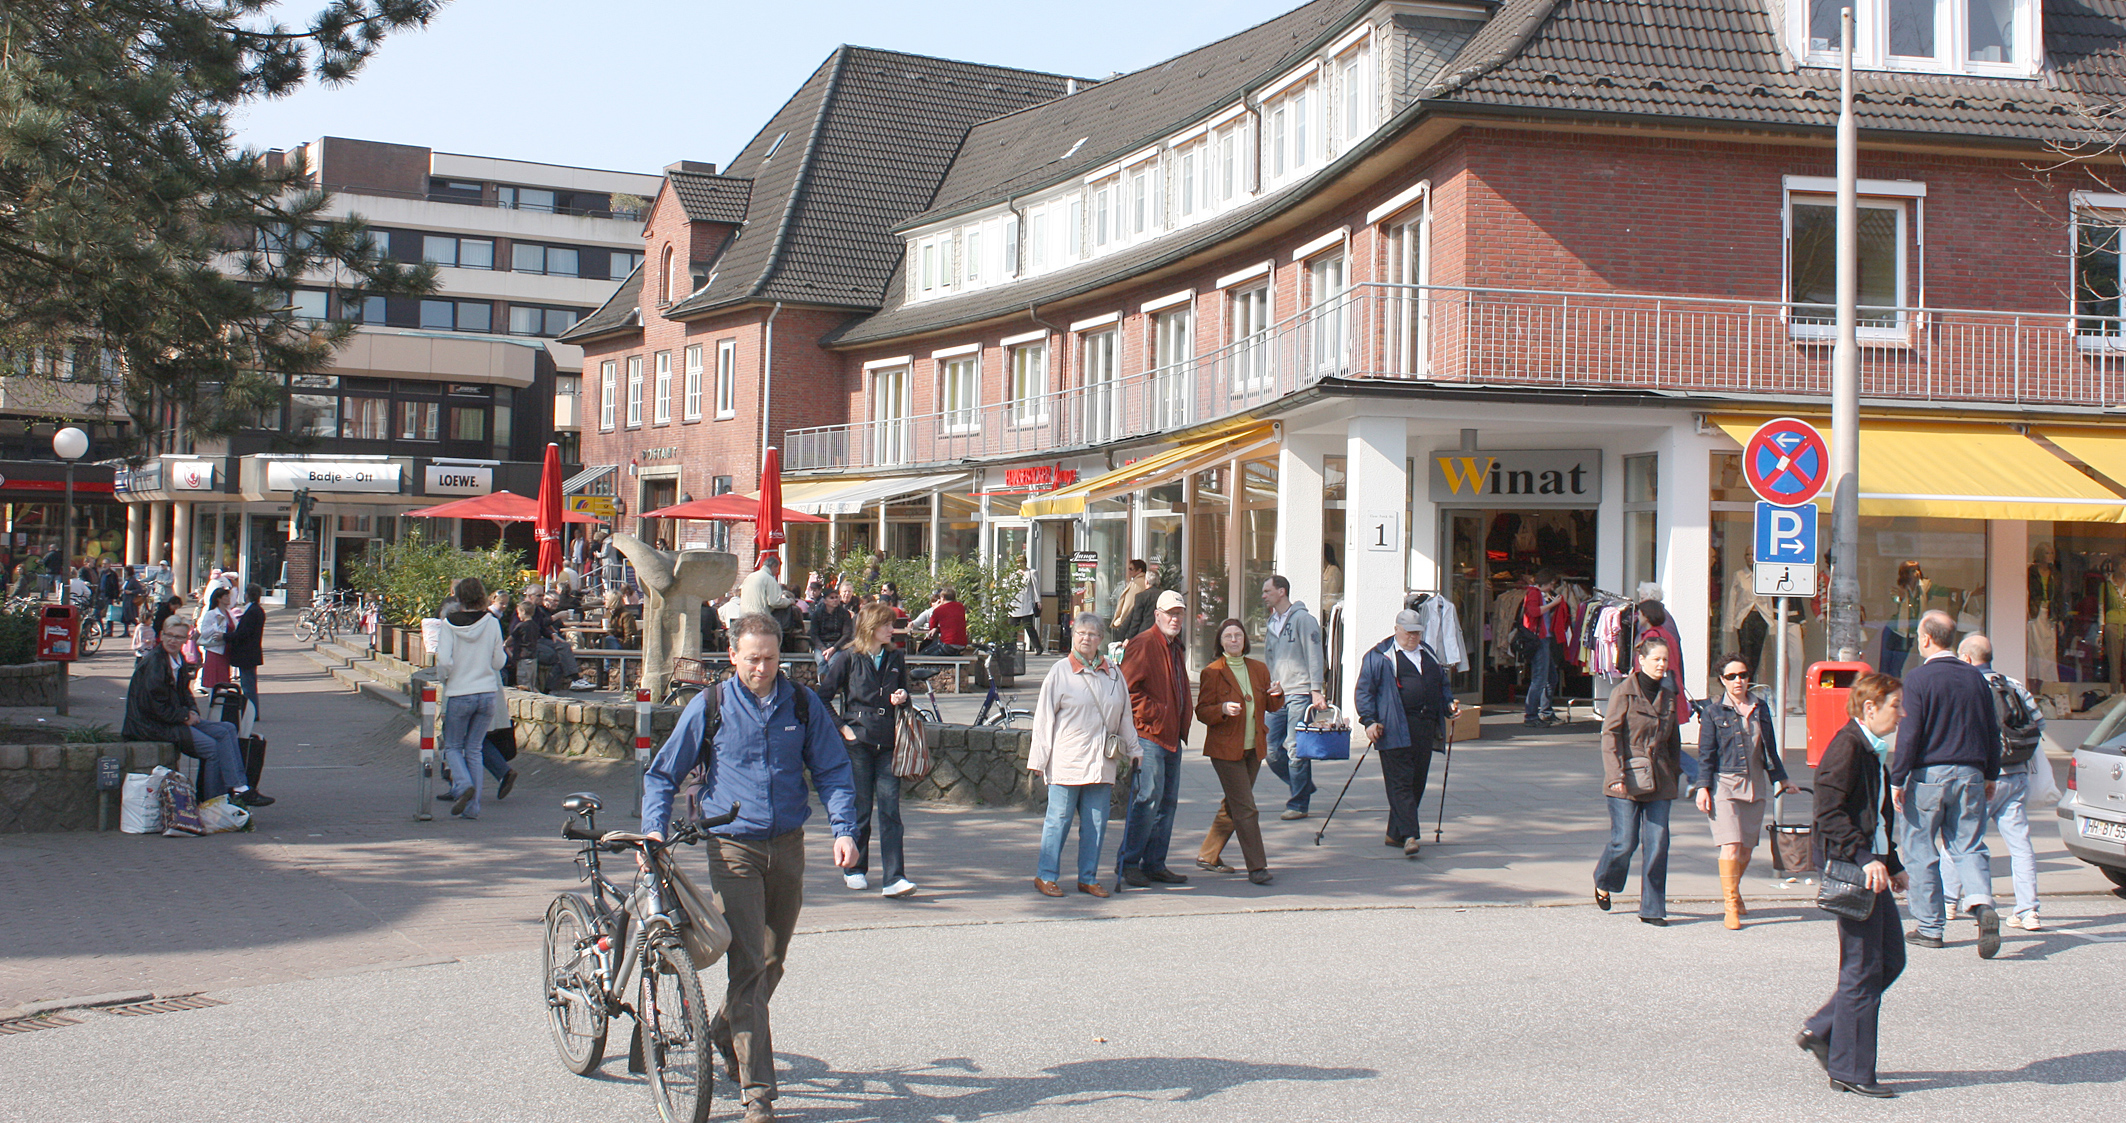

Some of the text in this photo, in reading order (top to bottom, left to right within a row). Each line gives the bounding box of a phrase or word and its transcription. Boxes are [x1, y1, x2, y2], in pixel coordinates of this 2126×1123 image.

[642, 446, 678, 461] POSTAMT
[308, 471, 342, 484] Badje
[355, 471, 373, 482] Ott
[1435, 456, 1588, 496] Winat
[1374, 523, 1388, 547] 1
[1769, 510, 1803, 556] P
[1073, 551, 1097, 562] Junge
